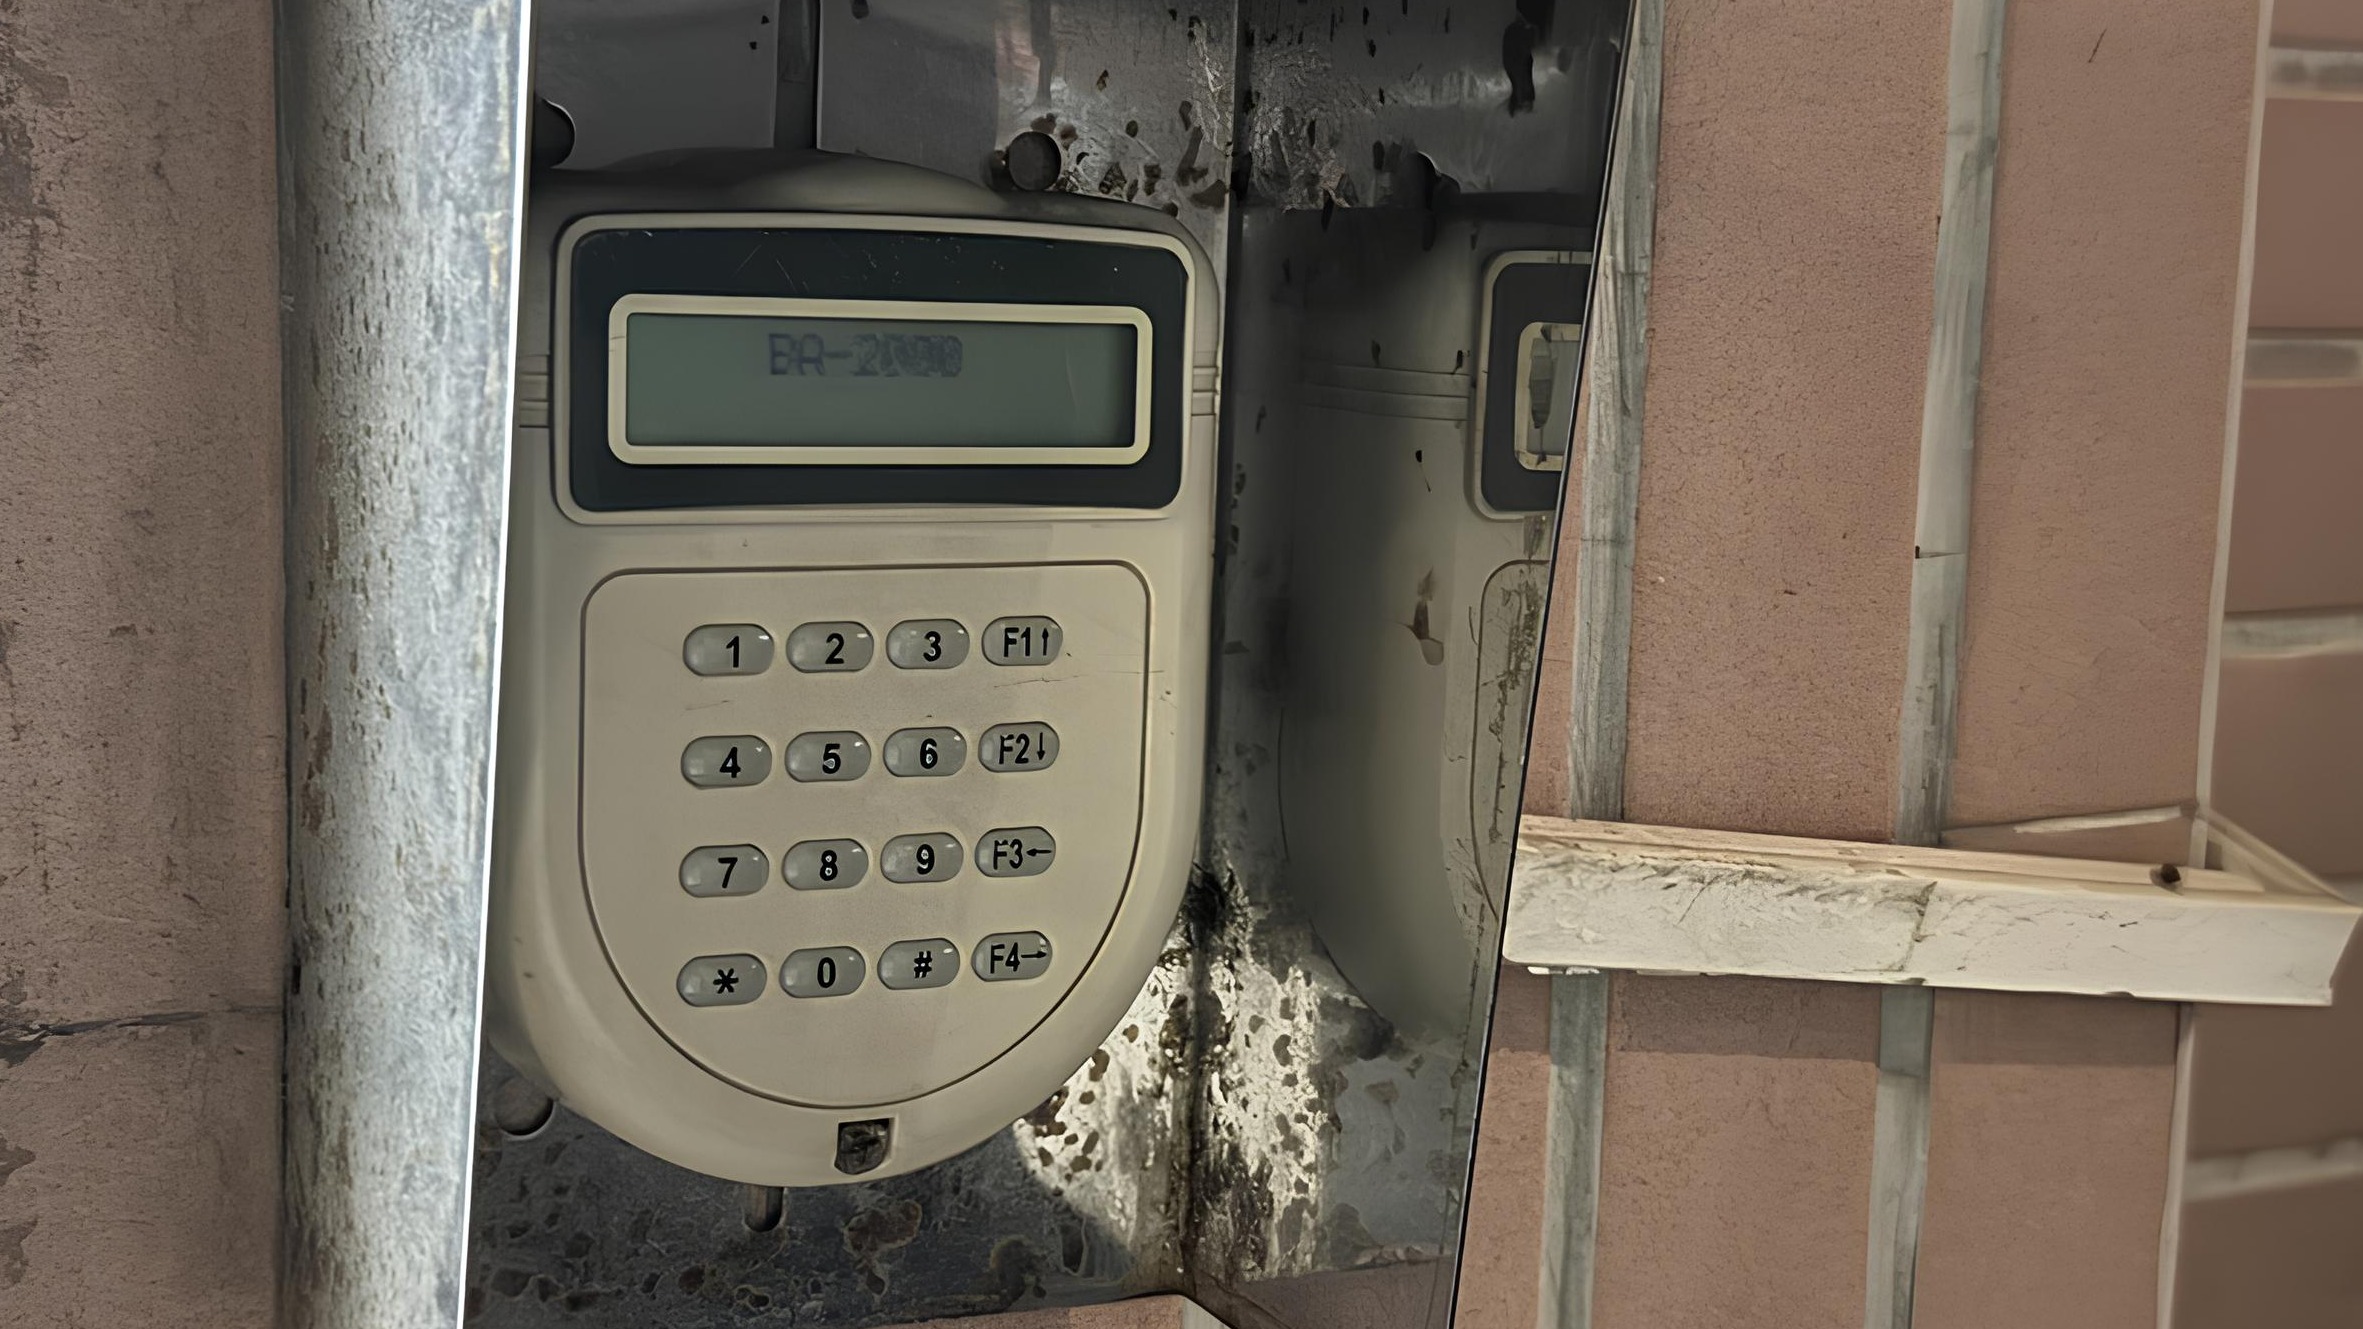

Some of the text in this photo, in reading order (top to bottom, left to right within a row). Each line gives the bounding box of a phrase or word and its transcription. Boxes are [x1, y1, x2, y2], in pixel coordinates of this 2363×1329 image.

[725, 635, 740, 669] 1
[824, 632, 845, 665] 2
[922, 630, 942, 663] 3
[719, 746, 742, 779] 4
[821, 742, 842, 775] 5
[919, 737, 939, 770] 6
[717, 856, 739, 889] 7
[819, 849, 839, 882] 8
[915, 843, 936, 876] 9
[816, 956, 837, 989] 0
[913, 950, 933, 979] #
